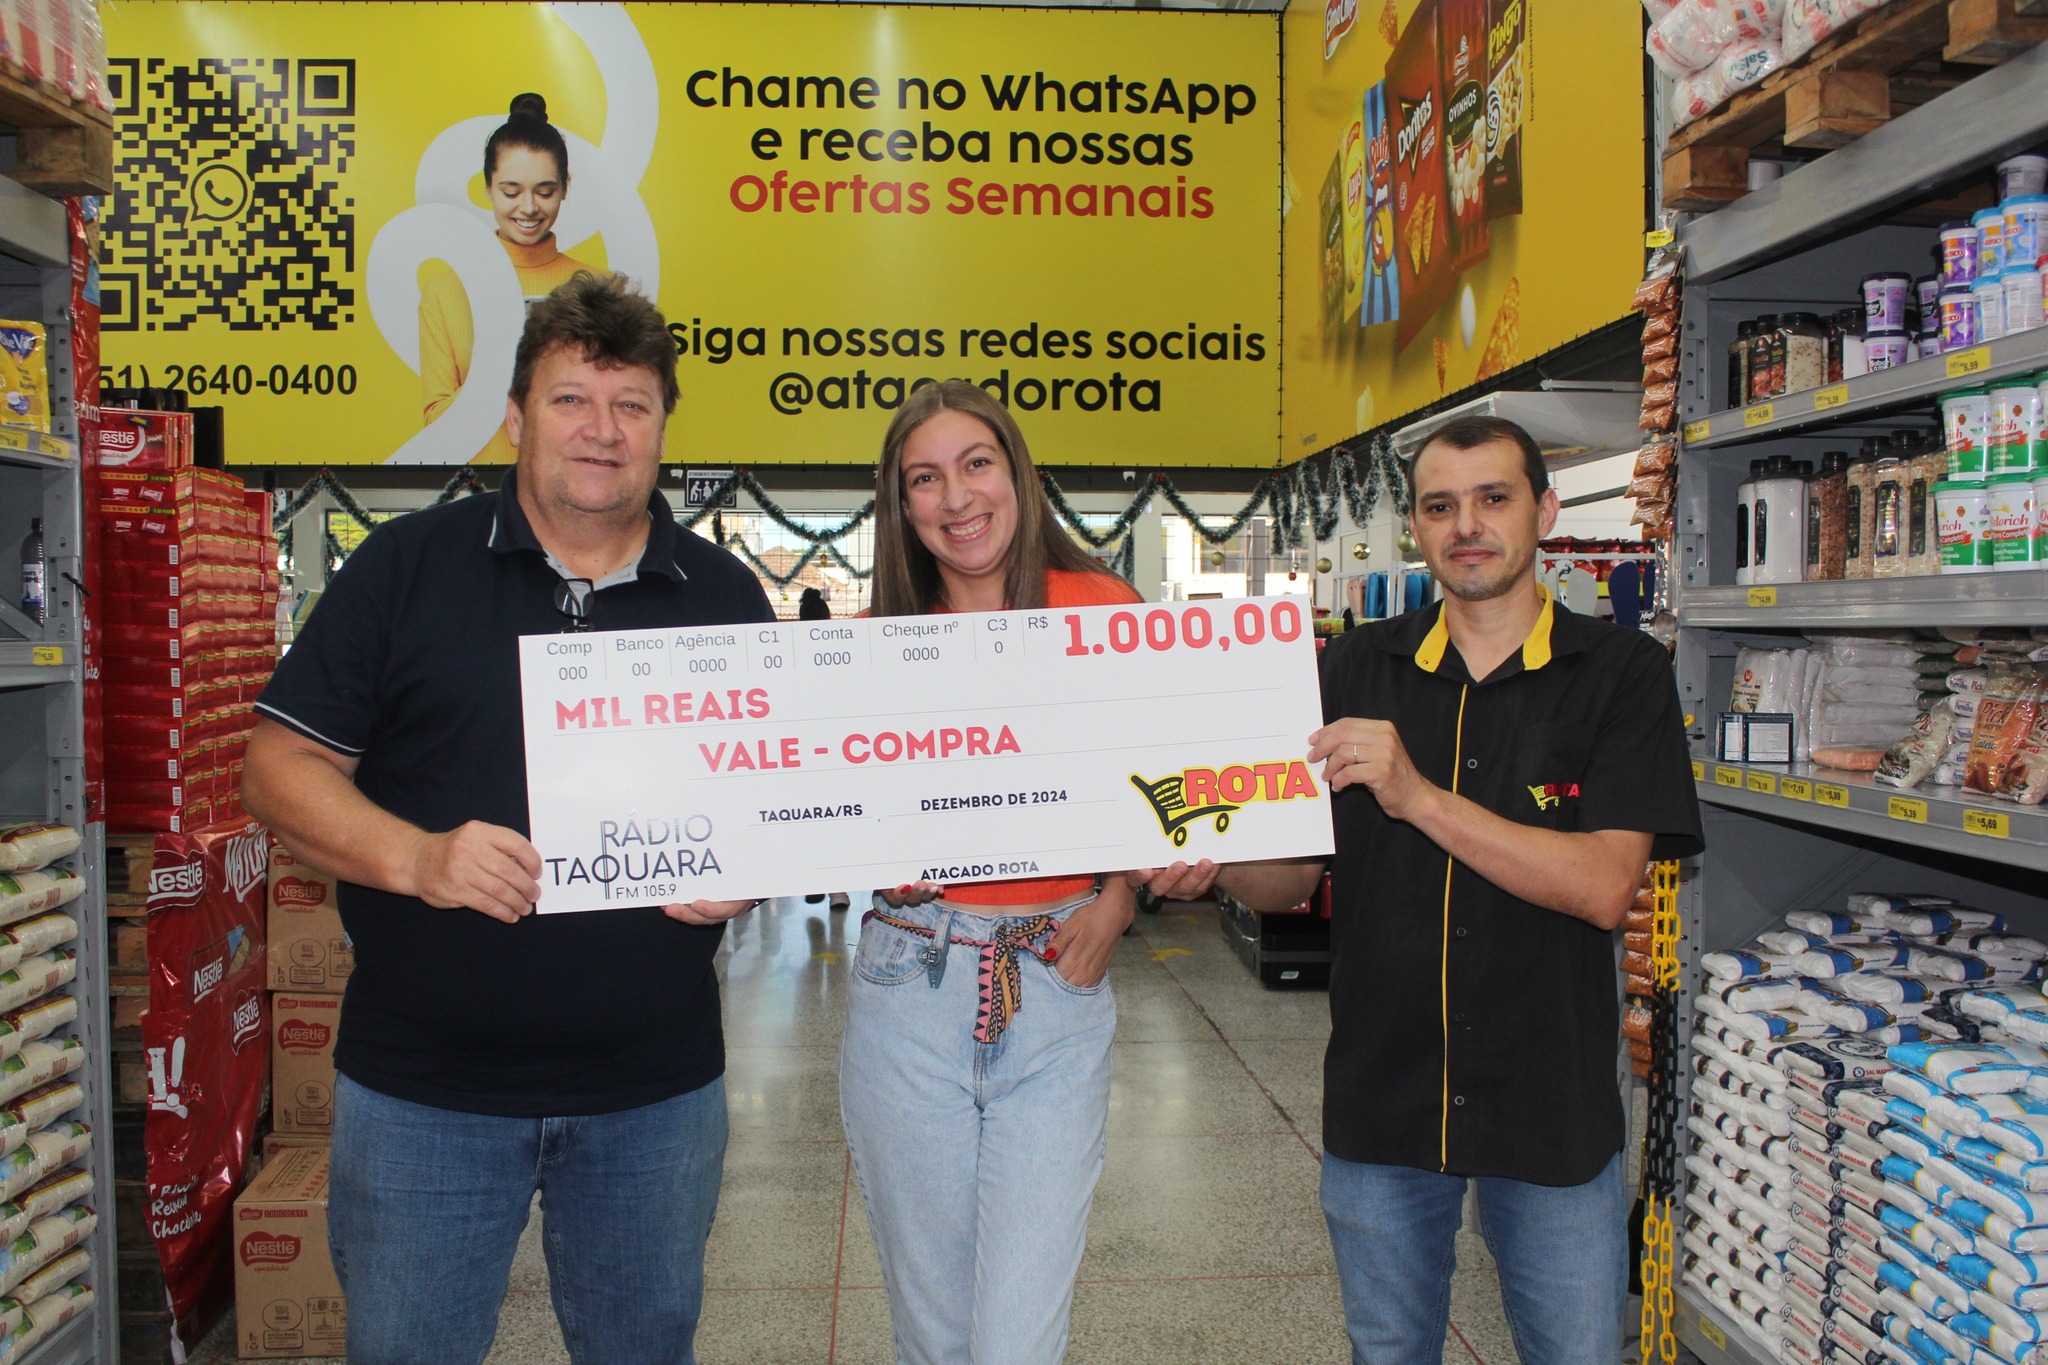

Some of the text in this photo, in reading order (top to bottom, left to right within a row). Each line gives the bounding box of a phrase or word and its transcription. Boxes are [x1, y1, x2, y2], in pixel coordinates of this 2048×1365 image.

[686, 67, 1257, 124] Chame no WhatsApp
[751, 122, 1193, 166] e receba nossas
[1398, 91, 1432, 163] Doritos
[730, 170, 1214, 219] Ofertas Semanais
[783, 325, 945, 357] nossas
[961, 322, 1092, 359] redes
[1106, 323, 1265, 361] sociais
[164, 364, 358, 396] 2640-0400
[770, 369, 1161, 415] @atadorota
[547, 601, 1302, 657] Comp Banco Agência C1 Conta Cheque nº C3 R$ 1.000,00
[558, 641, 1004, 681] 000 00 0000 00 0000 0000 0
[555, 688, 771, 730] MIL REAIS
[698, 738, 801, 773] VALE
[841, 724, 1021, 764] COMPRA
[1183, 761, 1319, 807] ROTA
[759, 789, 1068, 823] TAQUARA/RS DEZEMBRO DE 2024
[601, 808, 713, 848] RÁDIO
[545, 847, 722, 887] TAQUARA
[920, 861, 1040, 882] ATACADO ROTA
[279, 885, 322, 898] Nestlé
[616, 883, 677, 900] FM 105.9
[194, 956, 223, 995] Nestlé
[233, 995, 259, 1032] Nestlé
[283, 1028, 326, 1041] Nestlé
[246, 1240, 296, 1256] Nestlé
